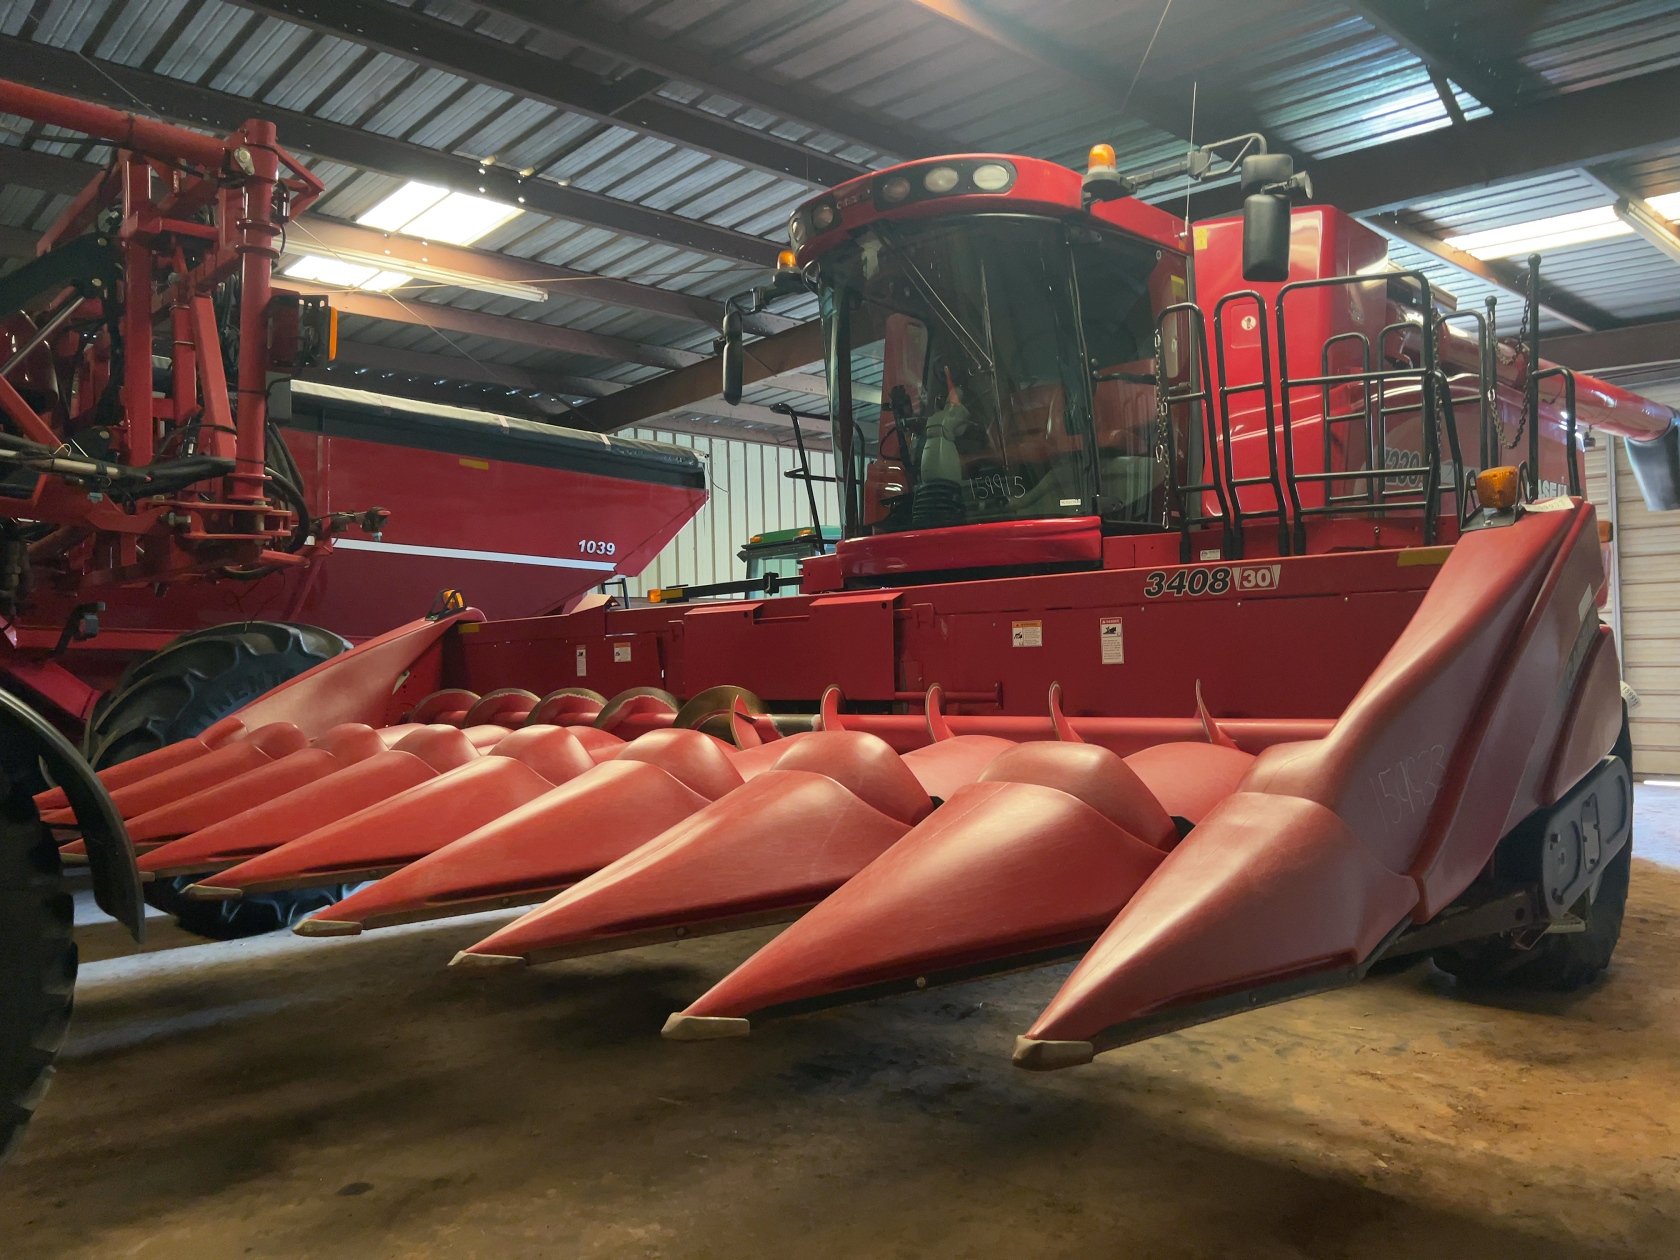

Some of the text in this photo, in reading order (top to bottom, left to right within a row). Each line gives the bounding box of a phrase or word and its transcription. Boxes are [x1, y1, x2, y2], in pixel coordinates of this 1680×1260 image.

[969, 473, 1026, 501] 159915
[578, 539, 616, 556] 1039
[1143, 566, 1271, 599] 3408 30
